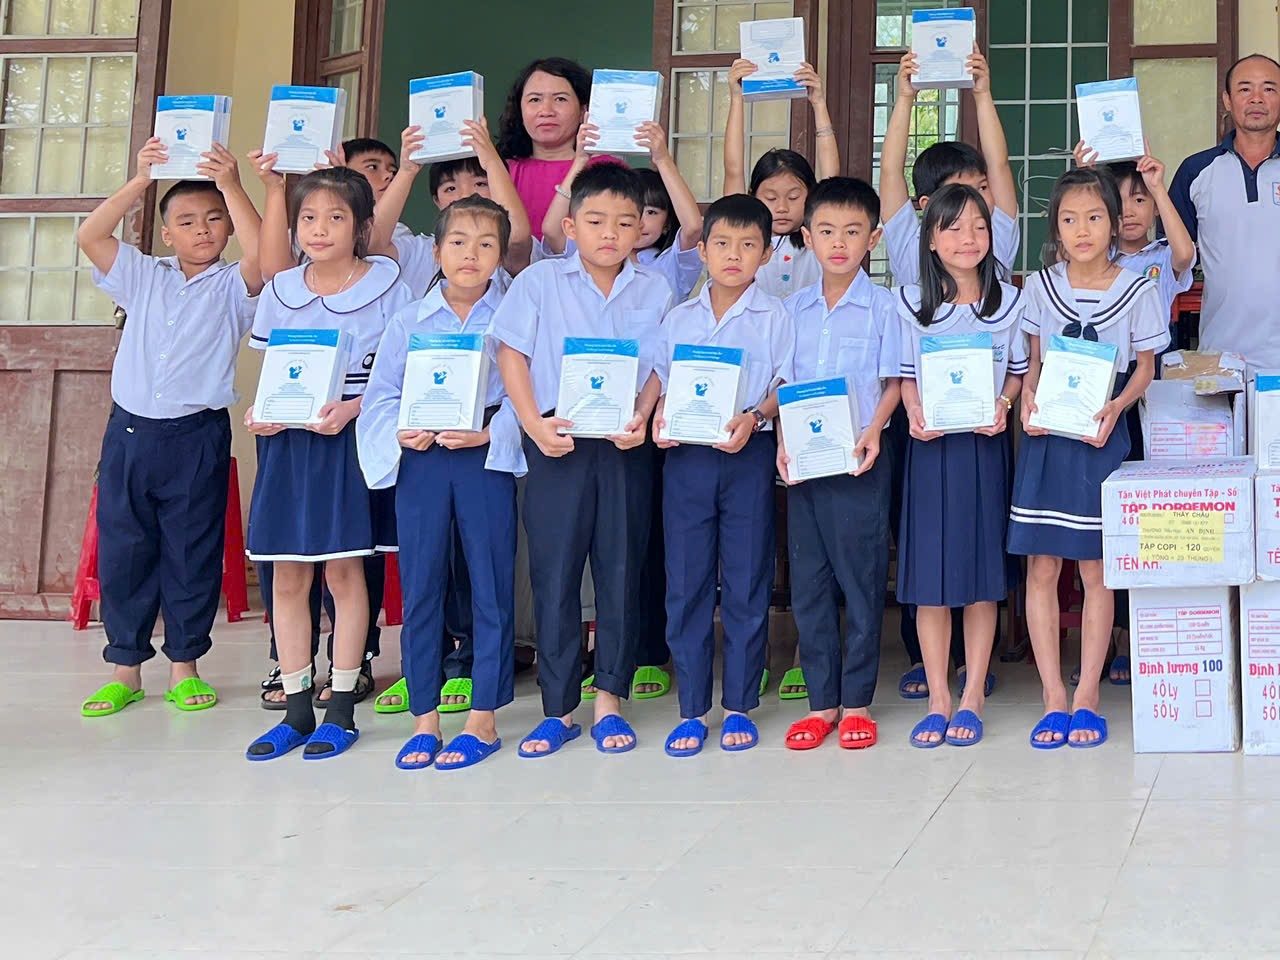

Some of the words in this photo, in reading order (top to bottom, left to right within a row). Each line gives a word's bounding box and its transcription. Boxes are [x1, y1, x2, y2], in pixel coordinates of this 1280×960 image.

[1118, 490, 1133, 499] Tân
[1135, 489, 1151, 500] Việt
[1153, 489, 1172, 499] Phát
[1174, 488, 1202, 499] chuyên
[1204, 488, 1219, 499] Tập
[1227, 486, 1238, 496] Số
[1122, 517, 1127, 525] 4
[1275, 511, 1280, 519] 4
[1157, 543, 1177, 551] COPI
[1186, 543, 1201, 551] 120
[1116, 554, 1139, 571] TÊN
[1139, 661, 1164, 677] Định
[1167, 661, 1199, 676] lượng
[1202, 659, 1223, 673] 100
[1249, 663, 1274, 679] Định
[1152, 683, 1158, 697] 4
[1159, 679, 1166, 698] Ô
[1168, 683, 1178, 700] Ly
[1262, 685, 1268, 699] 4
[1269, 681, 1276, 699] Ô
[1153, 704, 1159, 719] 5
[1160, 700, 1167, 719] Ô
[1169, 704, 1179, 722] Ly
[1263, 706, 1268, 720] 5
[1269, 702, 1276, 721] Ô
